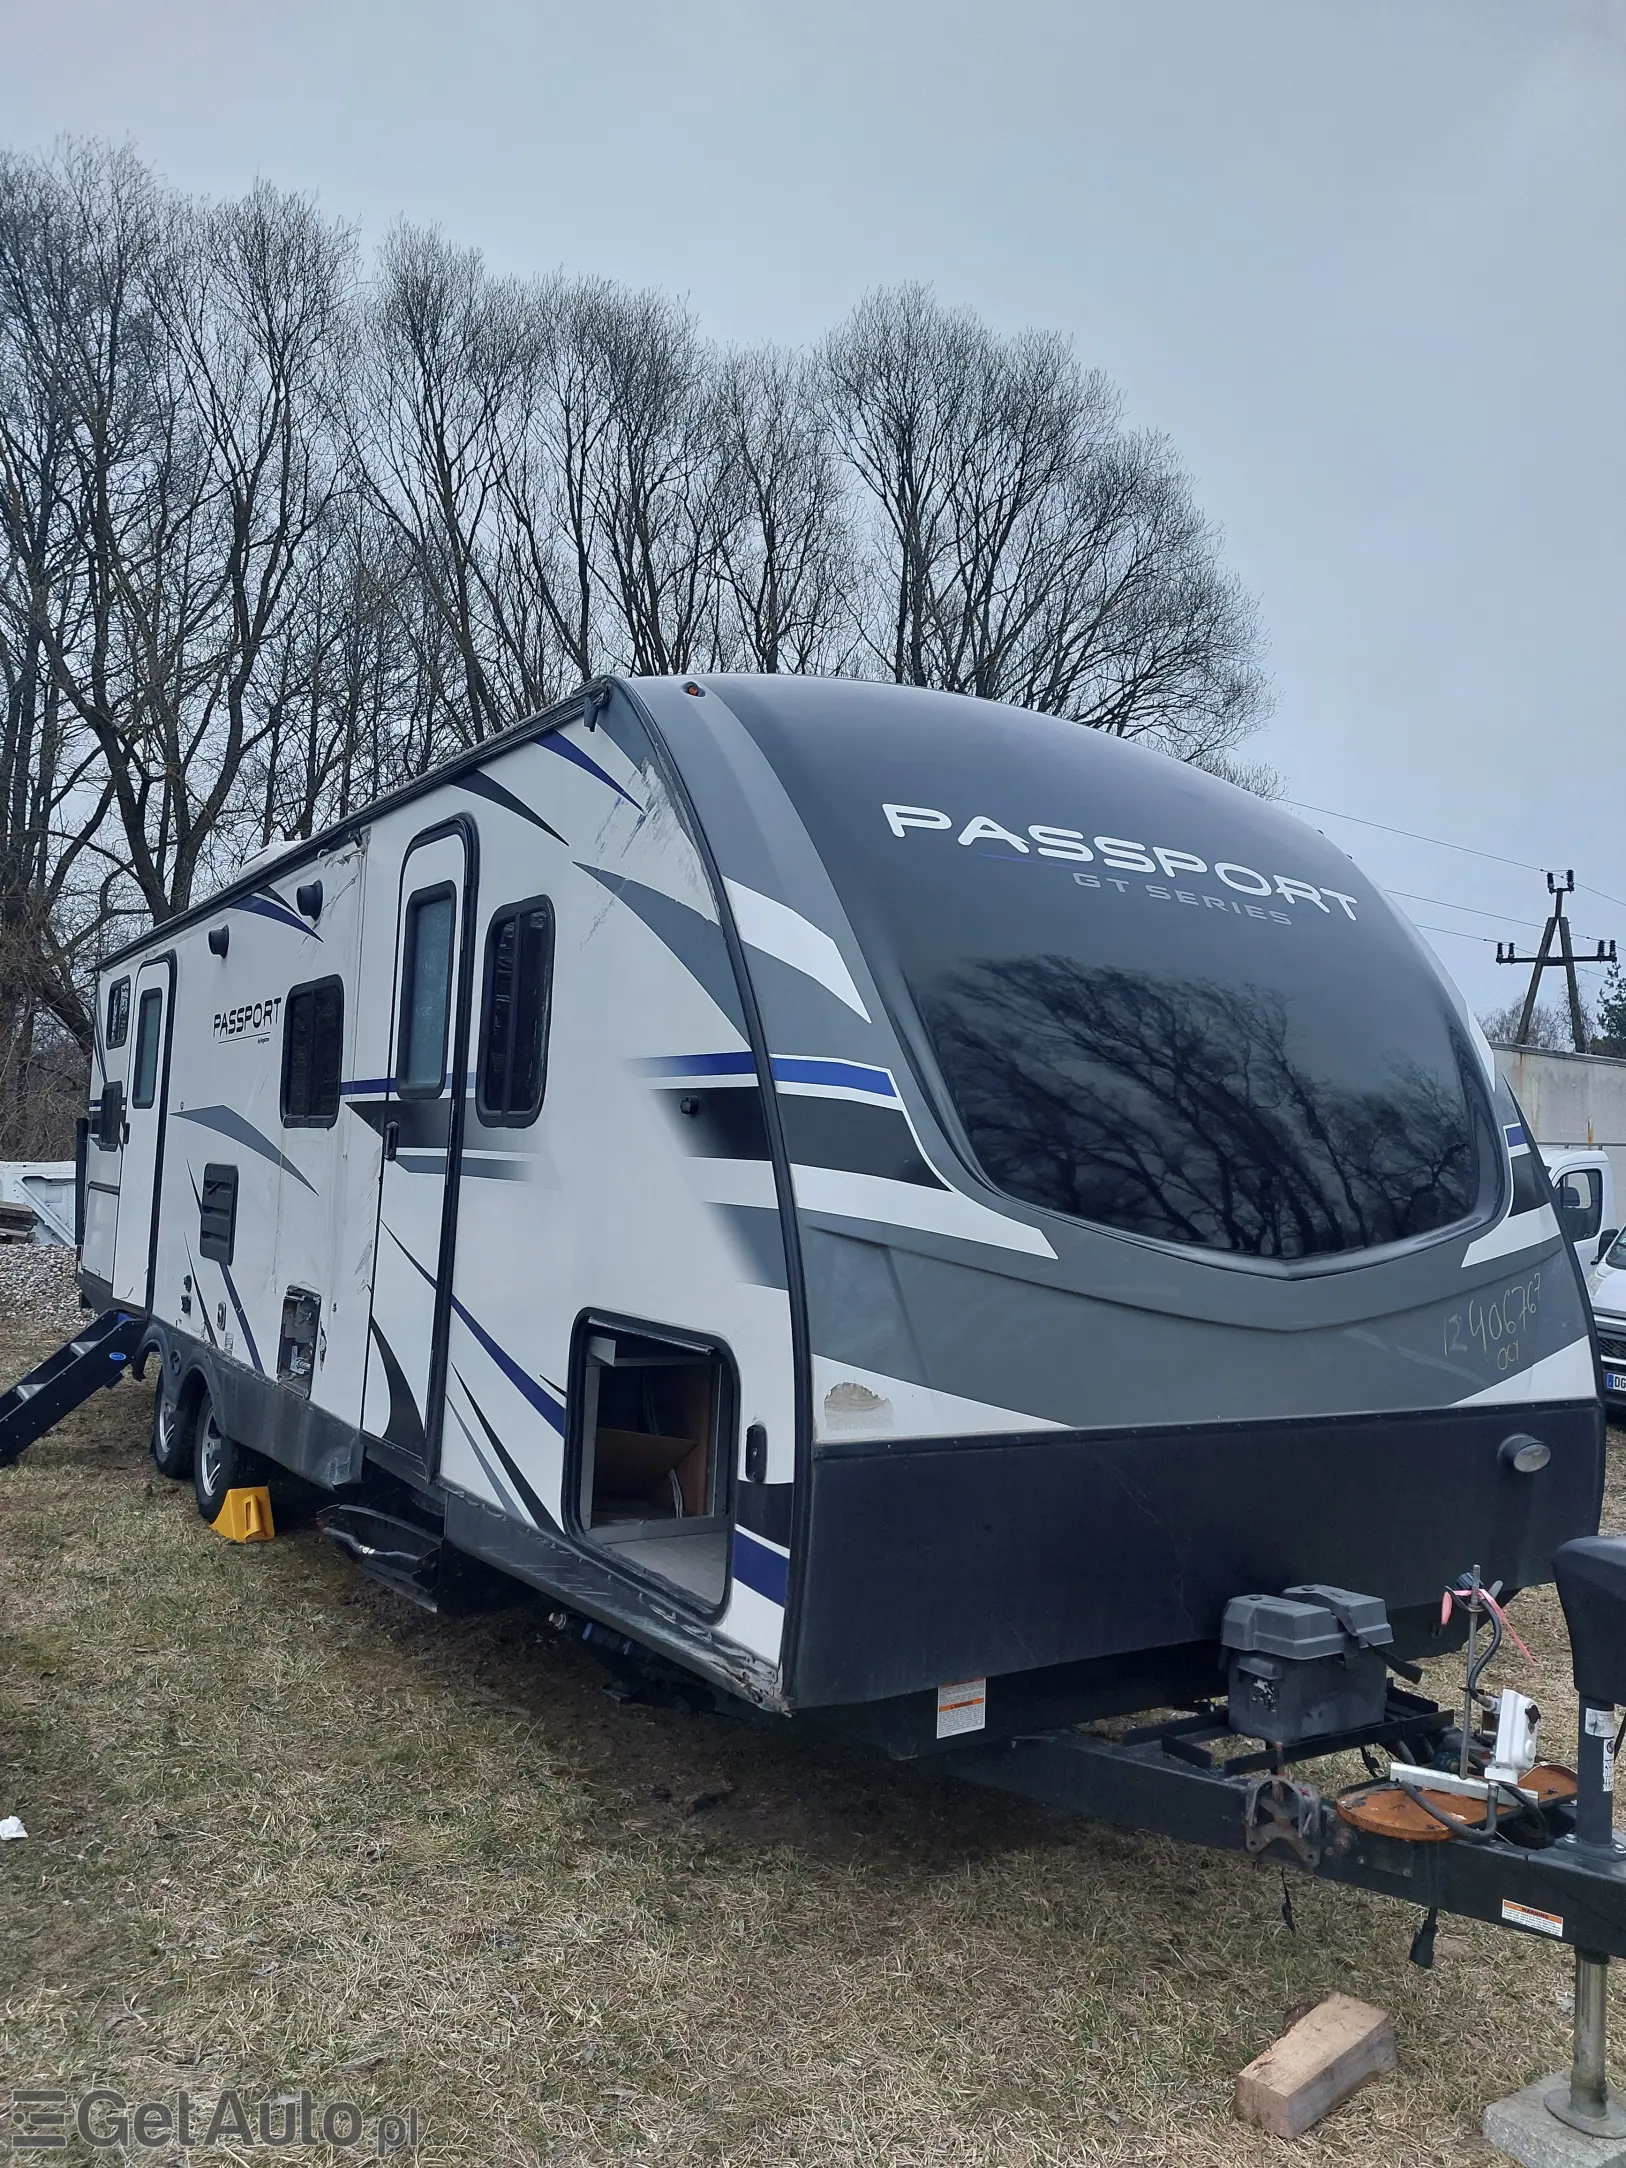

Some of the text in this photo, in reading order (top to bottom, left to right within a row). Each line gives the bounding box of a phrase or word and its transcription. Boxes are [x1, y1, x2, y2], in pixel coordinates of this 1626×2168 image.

[881, 803, 1359, 922] PASSPORT
[1072, 872, 1294, 927] GT SERIES
[213, 996, 282, 1038] PASSPORT
[1521, 1906, 1549, 1920] WARNING
